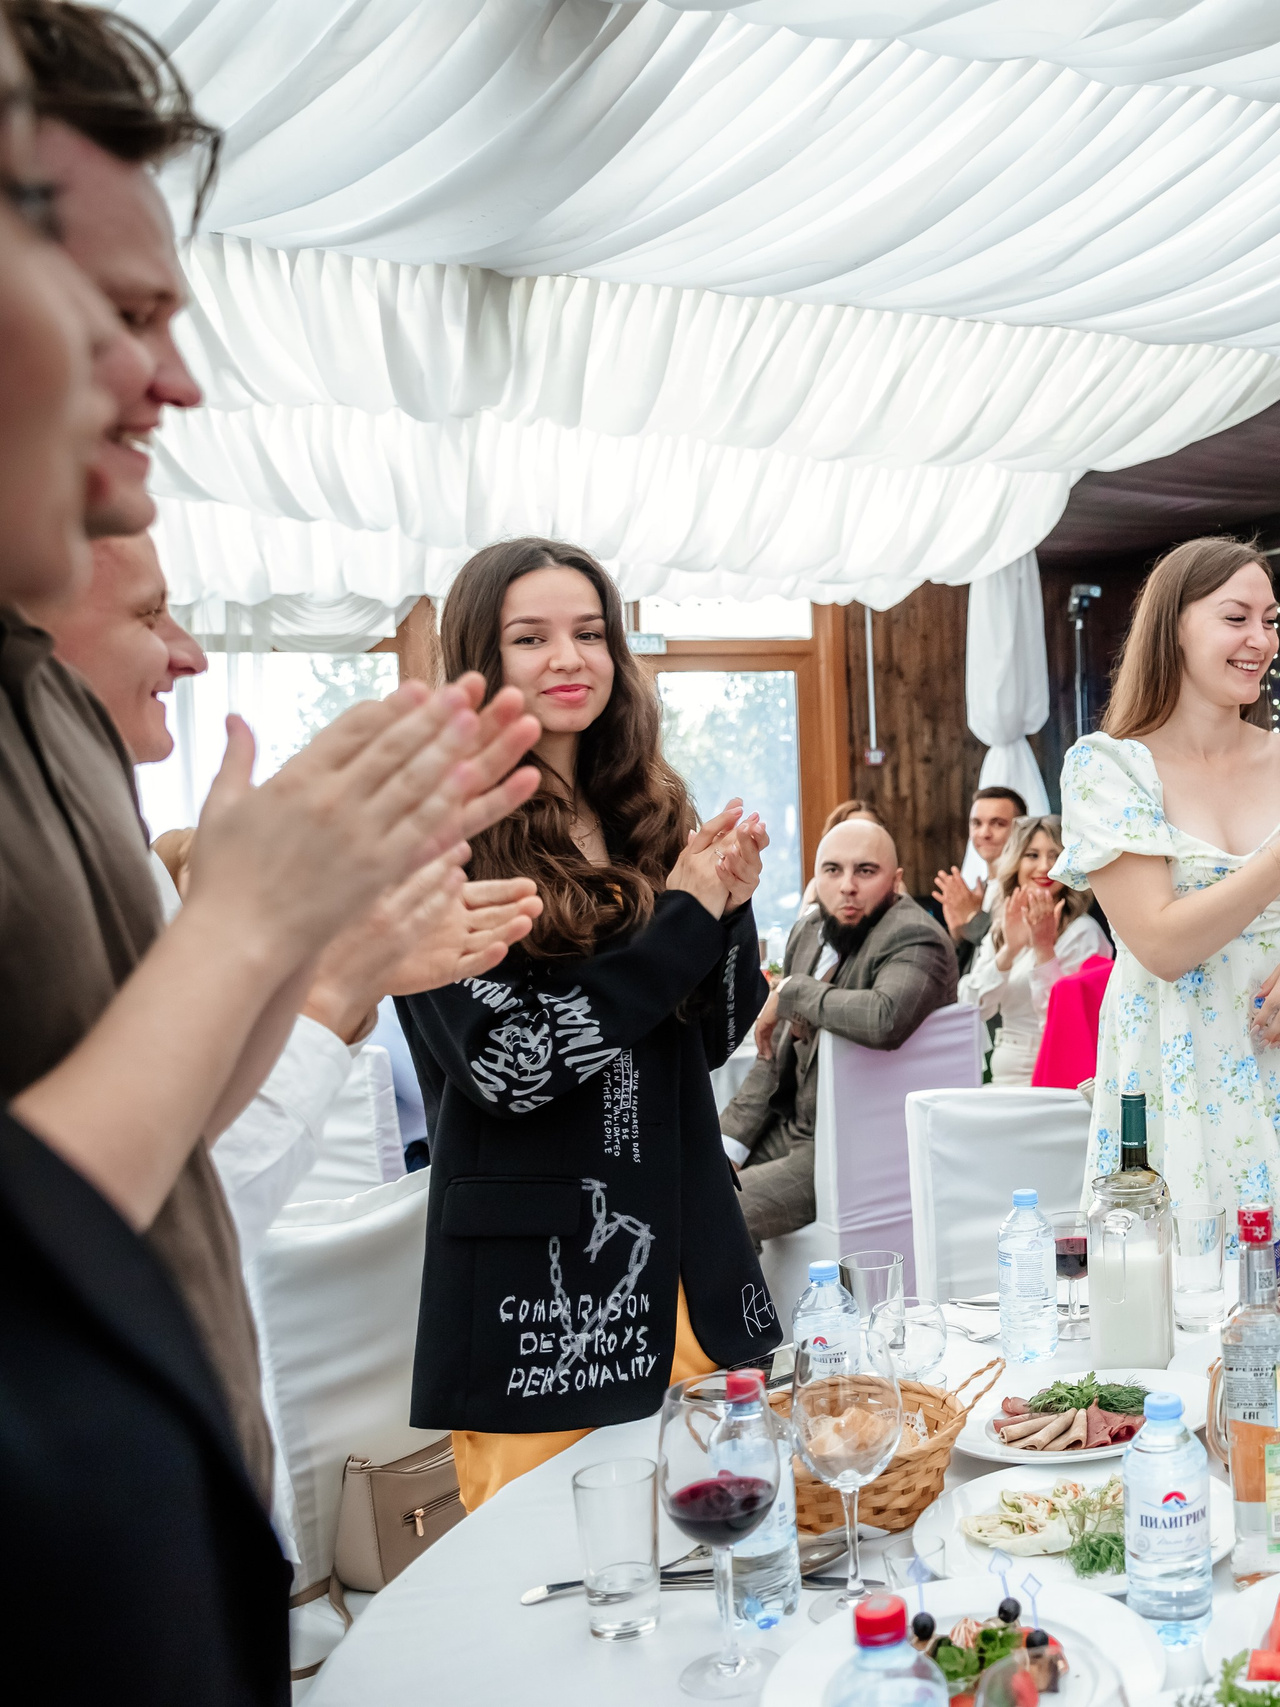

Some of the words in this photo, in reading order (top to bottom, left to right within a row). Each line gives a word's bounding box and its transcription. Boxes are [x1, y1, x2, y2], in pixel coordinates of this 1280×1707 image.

[622, 1054, 630, 1075] NOT
[603, 1071, 612, 1110] OTHER
[613, 1087, 621, 1101] OR
[622, 1079, 630, 1107] NEED
[612, 1105, 621, 1157] VALIDATED
[622, 1110, 630, 1123] TO
[631, 1095, 639, 1139] PROGRESS
[603, 1114, 612, 1154] PEOPLE
[621, 1128, 630, 1140] BE
[632, 1142, 641, 1164] DOES
[499, 1292, 650, 1323] COMPARISON
[520, 1325, 649, 1356] DESTROYS
[507, 1353, 659, 1398] PERSONALITY
